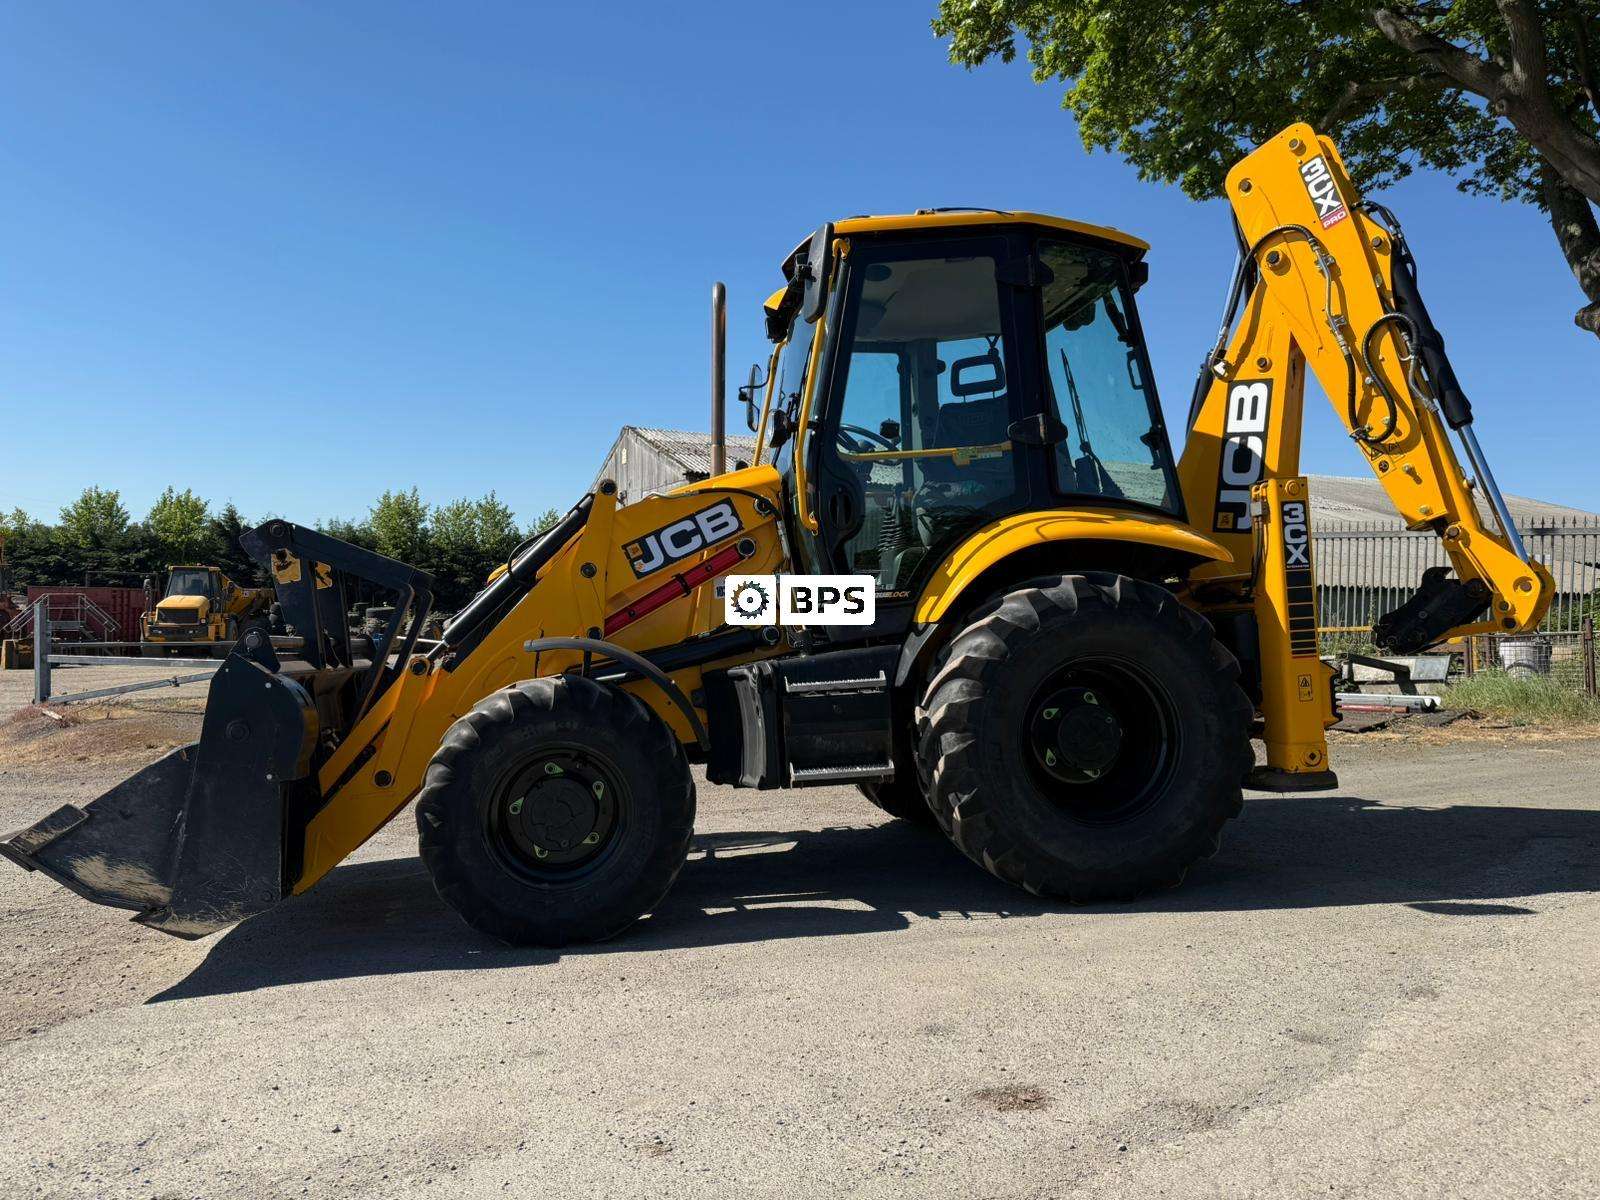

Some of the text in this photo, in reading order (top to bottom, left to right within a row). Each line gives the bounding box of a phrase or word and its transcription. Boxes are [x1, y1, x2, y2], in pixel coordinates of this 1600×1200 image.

[1301, 157, 1341, 216] 3CX
[1323, 210, 1347, 228] PRO
[1219, 382, 1268, 530] JCB
[634, 503, 739, 573] JCB
[1283, 503, 1309, 565] 3CX
